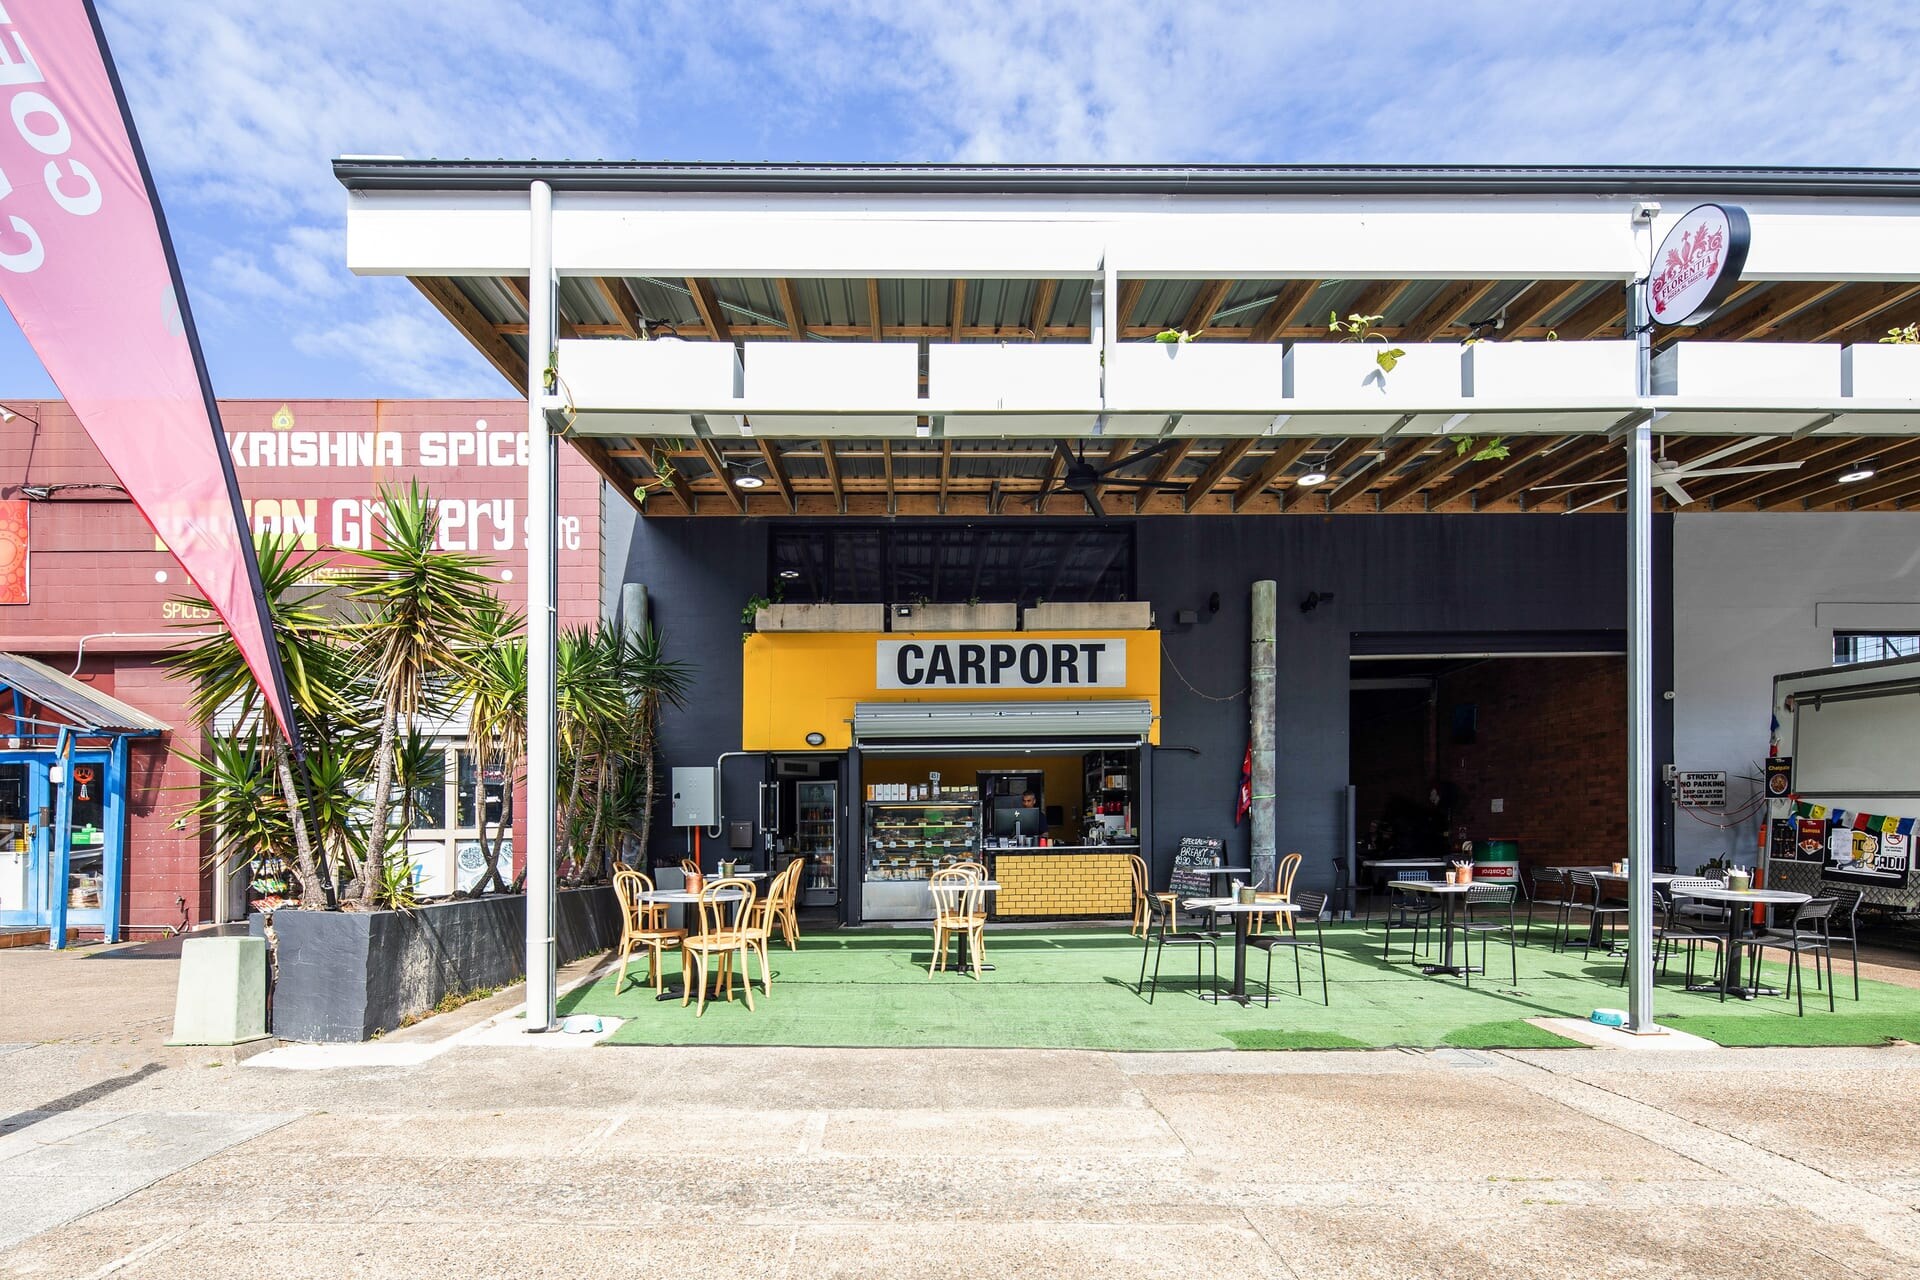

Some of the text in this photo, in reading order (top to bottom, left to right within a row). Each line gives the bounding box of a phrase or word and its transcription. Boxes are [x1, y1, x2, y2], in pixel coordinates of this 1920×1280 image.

[1662, 255, 1711, 298] FLORENTIA
[224, 431, 402, 468] KRISHNA
[162, 602, 210, 619] SPICES
[897, 643, 1105, 685] CARPORT
